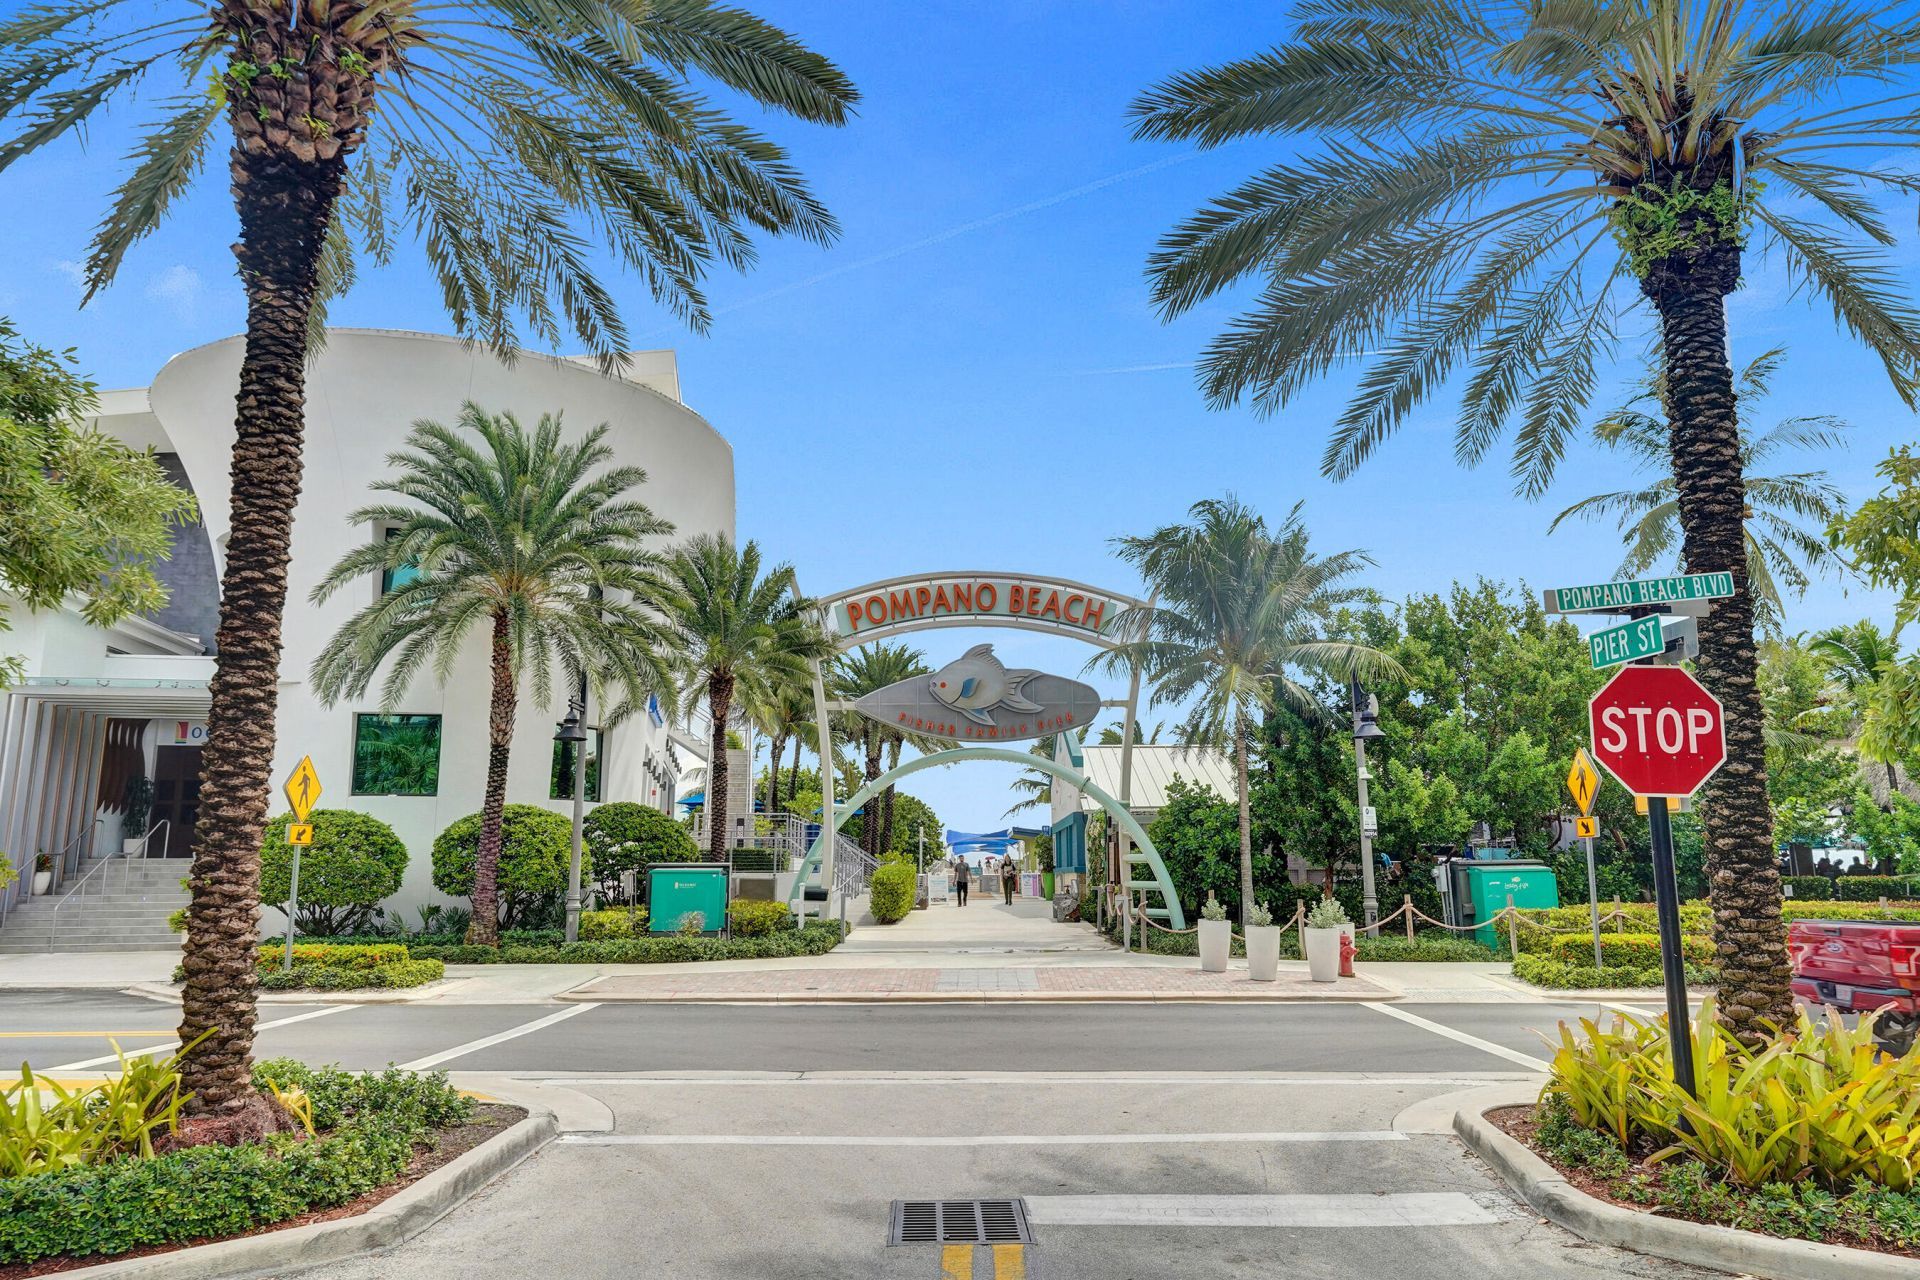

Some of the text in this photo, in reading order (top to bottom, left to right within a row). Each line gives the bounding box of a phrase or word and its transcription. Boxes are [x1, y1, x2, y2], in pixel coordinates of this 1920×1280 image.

[847, 582, 1105, 630] POMPANO BEACH
[1562, 575, 1728, 609] POMPANO BEACH BLVD
[1593, 620, 1657, 664] PIER ST
[1601, 706, 1714, 754] STOP
